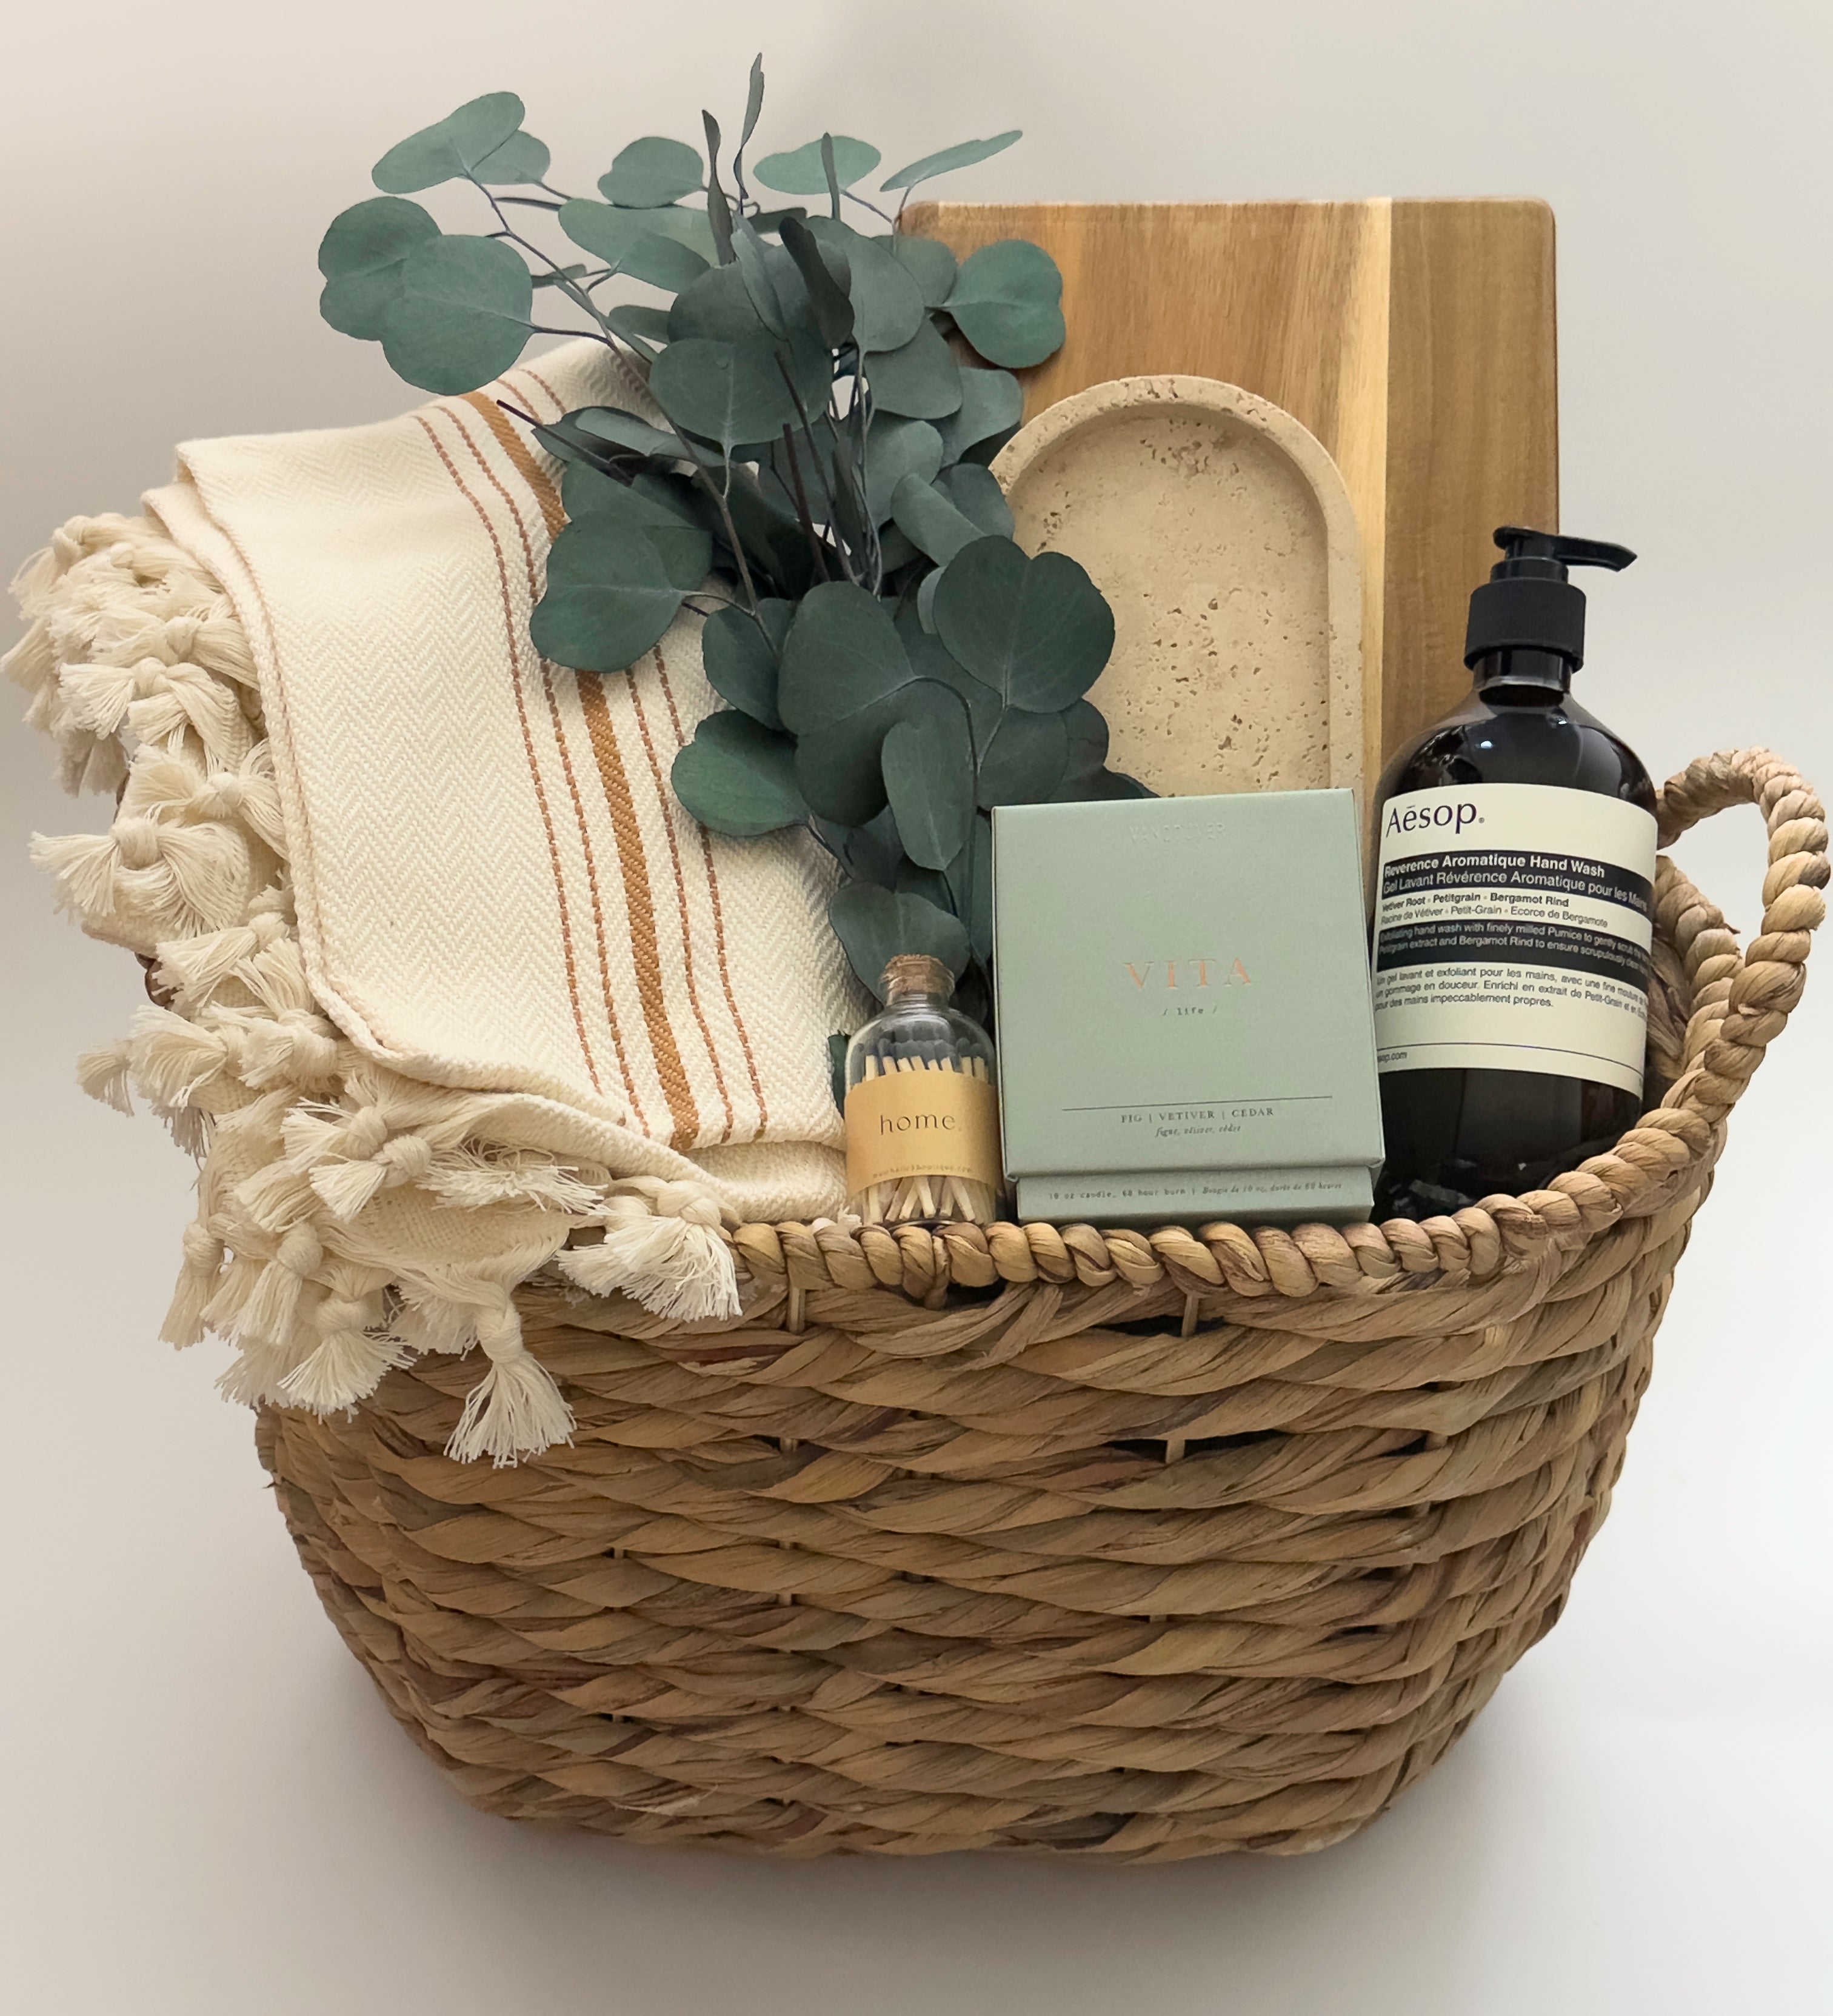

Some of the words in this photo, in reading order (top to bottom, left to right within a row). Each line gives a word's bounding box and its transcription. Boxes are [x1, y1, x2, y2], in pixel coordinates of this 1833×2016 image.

[1384, 858, 1439, 878] Reverence
[1442, 853, 1526, 869] Aromatique
[1530, 855, 1568, 871] Hand
[1571, 859, 1605, 878] Wash
[1383, 879, 1398, 895] Gel
[1399, 873, 1434, 891] Lavant
[1511, 870, 1585, 891] Aromatique
[1588, 883, 1613, 896] pour
[1614, 887, 1628, 901] les
[1406, 896, 1426, 907] Root
[1433, 892, 1480, 904] Petitgrain
[1491, 893, 1542, 904] Bergamot
[1546, 896, 1569, 907] Rind
[1451, 905, 1501, 915] Petit-Grain
[1548, 910, 1559, 918] de
[1414, 925, 1436, 935] hand
[1438, 923, 1462, 932] wash
[1464, 923, 1484, 932] with
[1487, 923, 1514, 934] finely
[1516, 925, 1545, 935] milled
[1548, 927, 1581, 940] Pumice
[1584, 933, 1592, 943] to
[1439, 936, 1457, 946] and
[1459, 936, 1507, 947] Bergamot
[1510, 936, 1533, 947] Rind
[1535, 939, 1544, 948] to
[1547, 942, 1578, 953] ensure
[1124, 956, 1252, 991] VITA
[1425, 969, 1434, 978] et
[1437, 968, 1476, 976] exfoliant
[1480, 969, 1503, 977] pour
[1507, 969, 1521, 978] les
[1561, 975, 1582, 985] avec
[1585, 980, 1600, 989] une
[1385, 984, 1421, 998] gommage
[1484, 980, 1518, 990] Enrichi
[1538, 985, 1568, 995] extrait
[1571, 989, 1581, 999] de
[1431, 993, 1510, 1004] impeccablement
[1177, 1007, 1204, 1015] life
[1121, 1113, 1143, 1123] FIG
[1158, 1110, 1215, 1121] VETIVER
[1232, 1107, 1274, 1118] CEDAR
